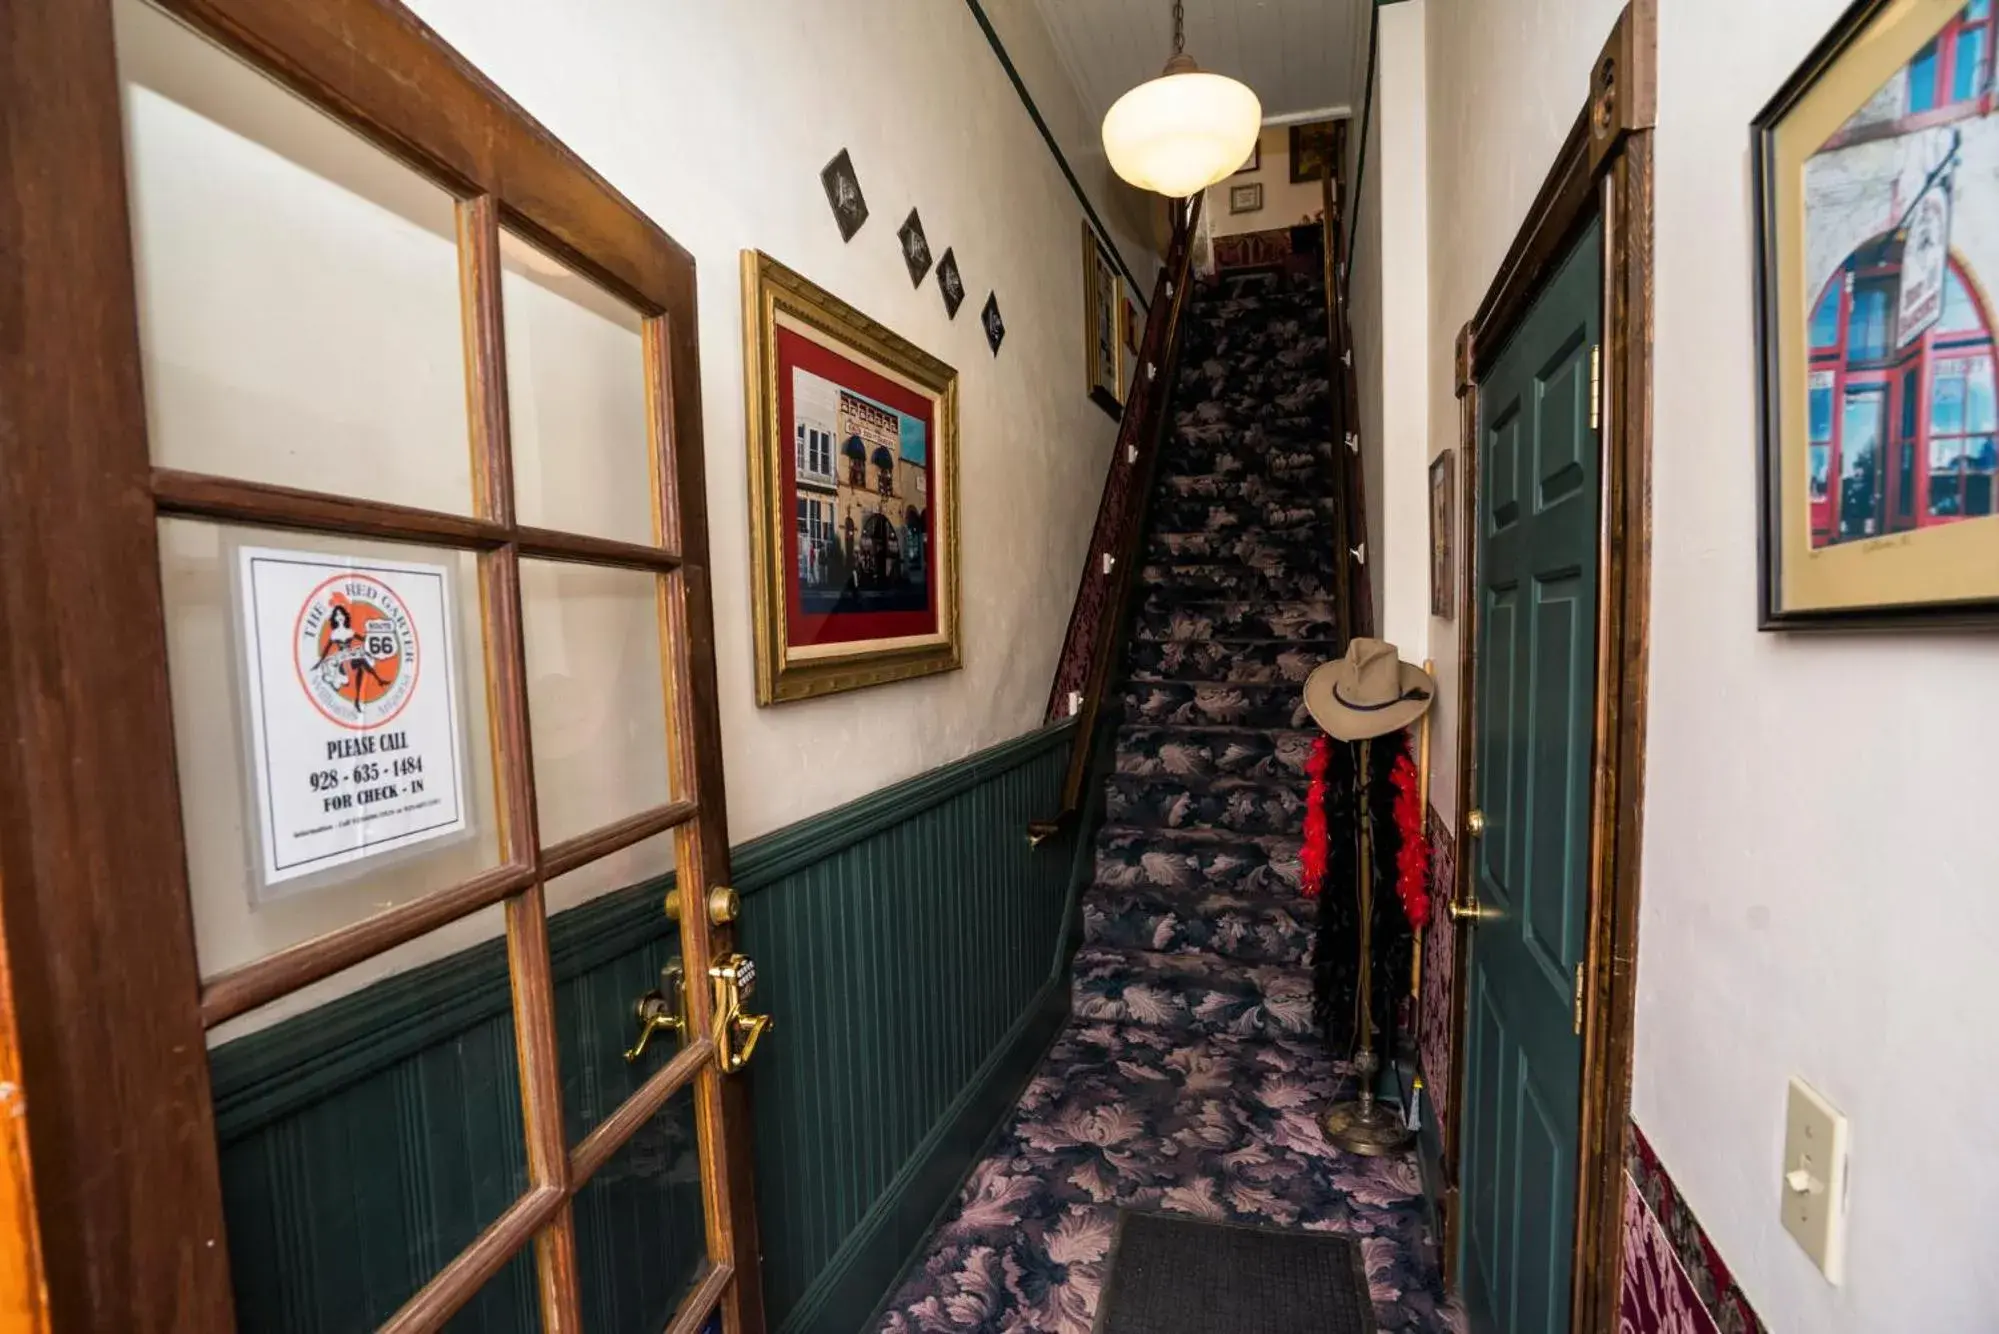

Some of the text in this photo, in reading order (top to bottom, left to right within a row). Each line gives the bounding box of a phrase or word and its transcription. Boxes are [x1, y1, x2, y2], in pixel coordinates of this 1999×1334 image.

[304, 583, 414, 663] THE RED GARTER
[369, 636, 393, 655] 66
[327, 732, 408, 760] PLEASE CALL
[309, 769, 338, 792] 928
[353, 762, 379, 784] 635
[393, 755, 423, 777] 1484
[323, 794, 353, 813] FOR
[357, 784, 398, 805] CHECK
[411, 780, 424, 794] IN
